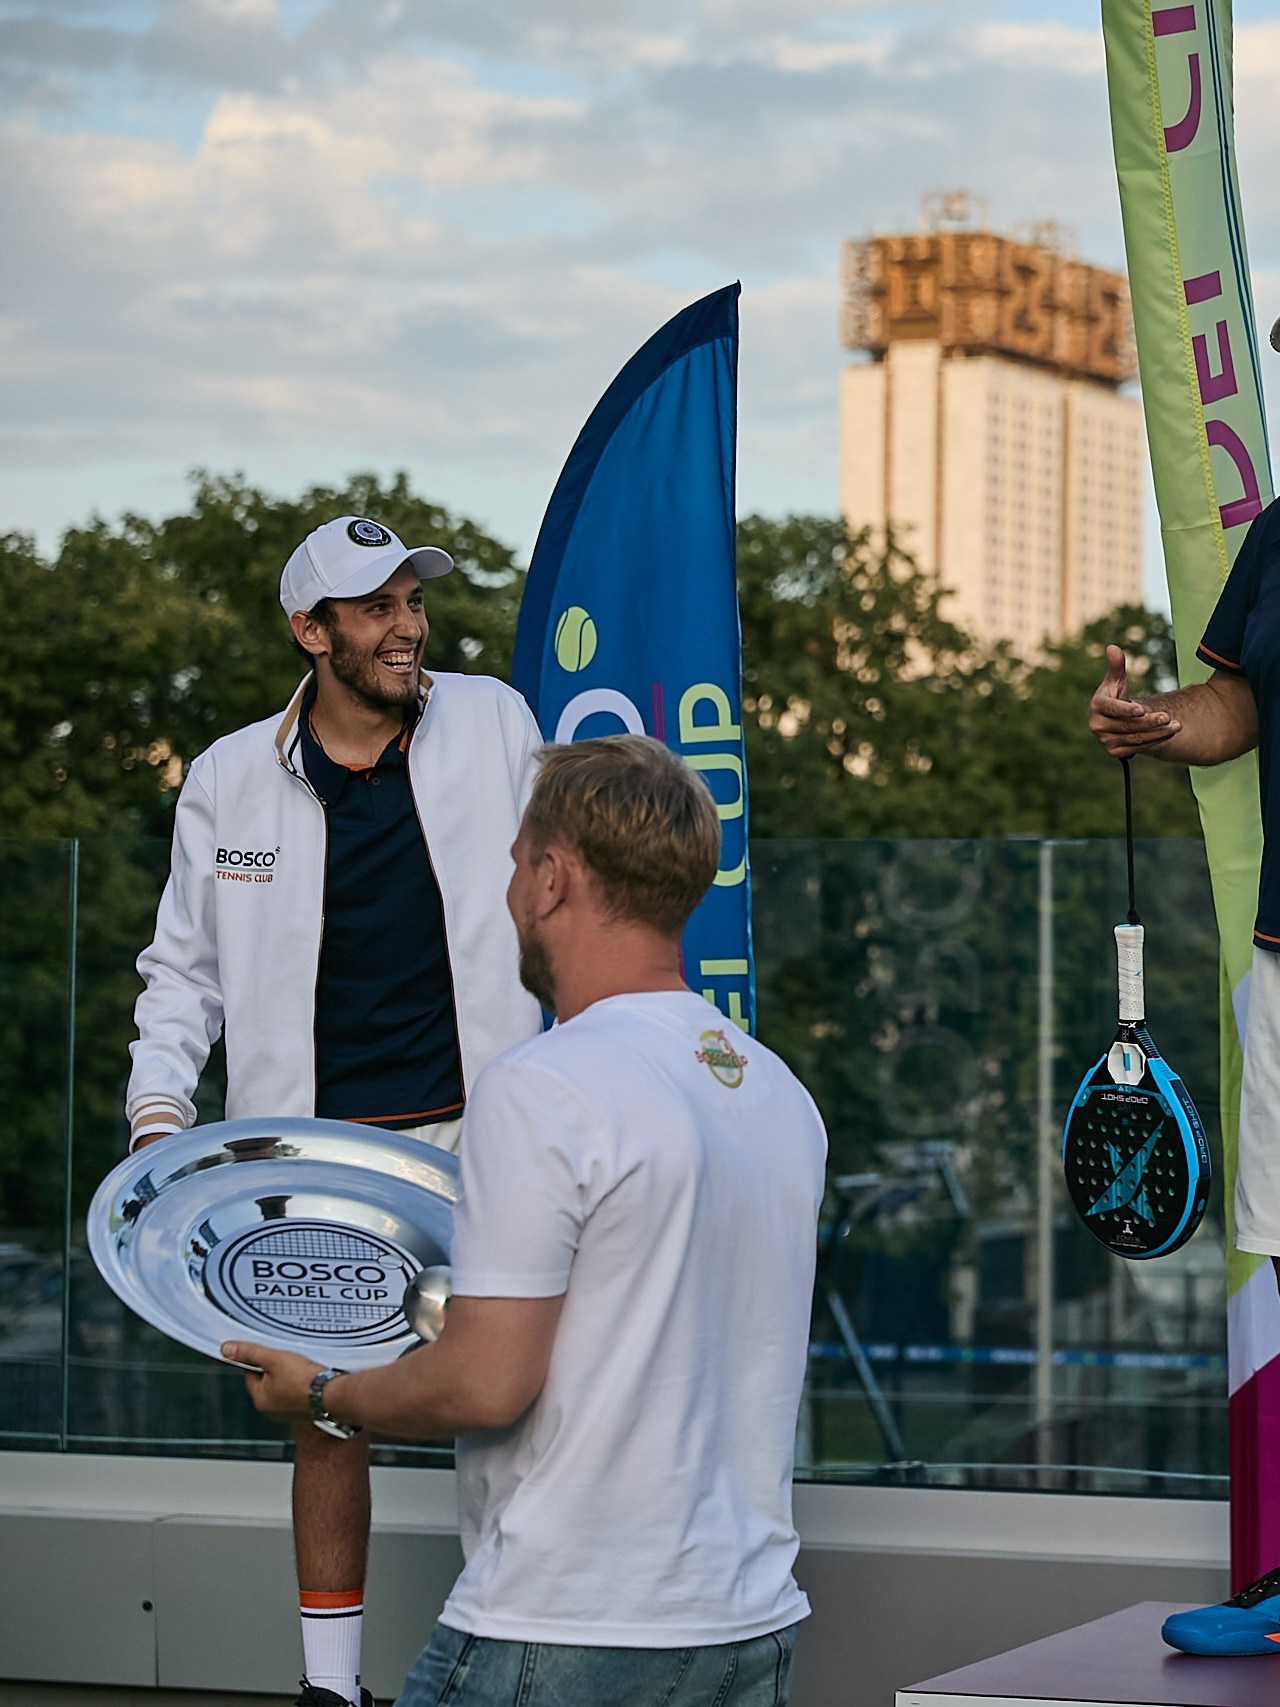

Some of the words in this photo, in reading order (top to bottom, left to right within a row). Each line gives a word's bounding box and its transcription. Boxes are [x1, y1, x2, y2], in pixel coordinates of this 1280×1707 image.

[216, 848, 276, 867] BOSCO
[215, 870, 252, 882] TENNIS
[254, 873, 274, 883] CLUB
[1125, 1096, 1149, 1104] DROP
[1196, 1129, 1208, 1164] DROP
[252, 1260, 386, 1284] BOSCO
[254, 1283, 331, 1299] PADEL
[340, 1288, 388, 1301] CUP
